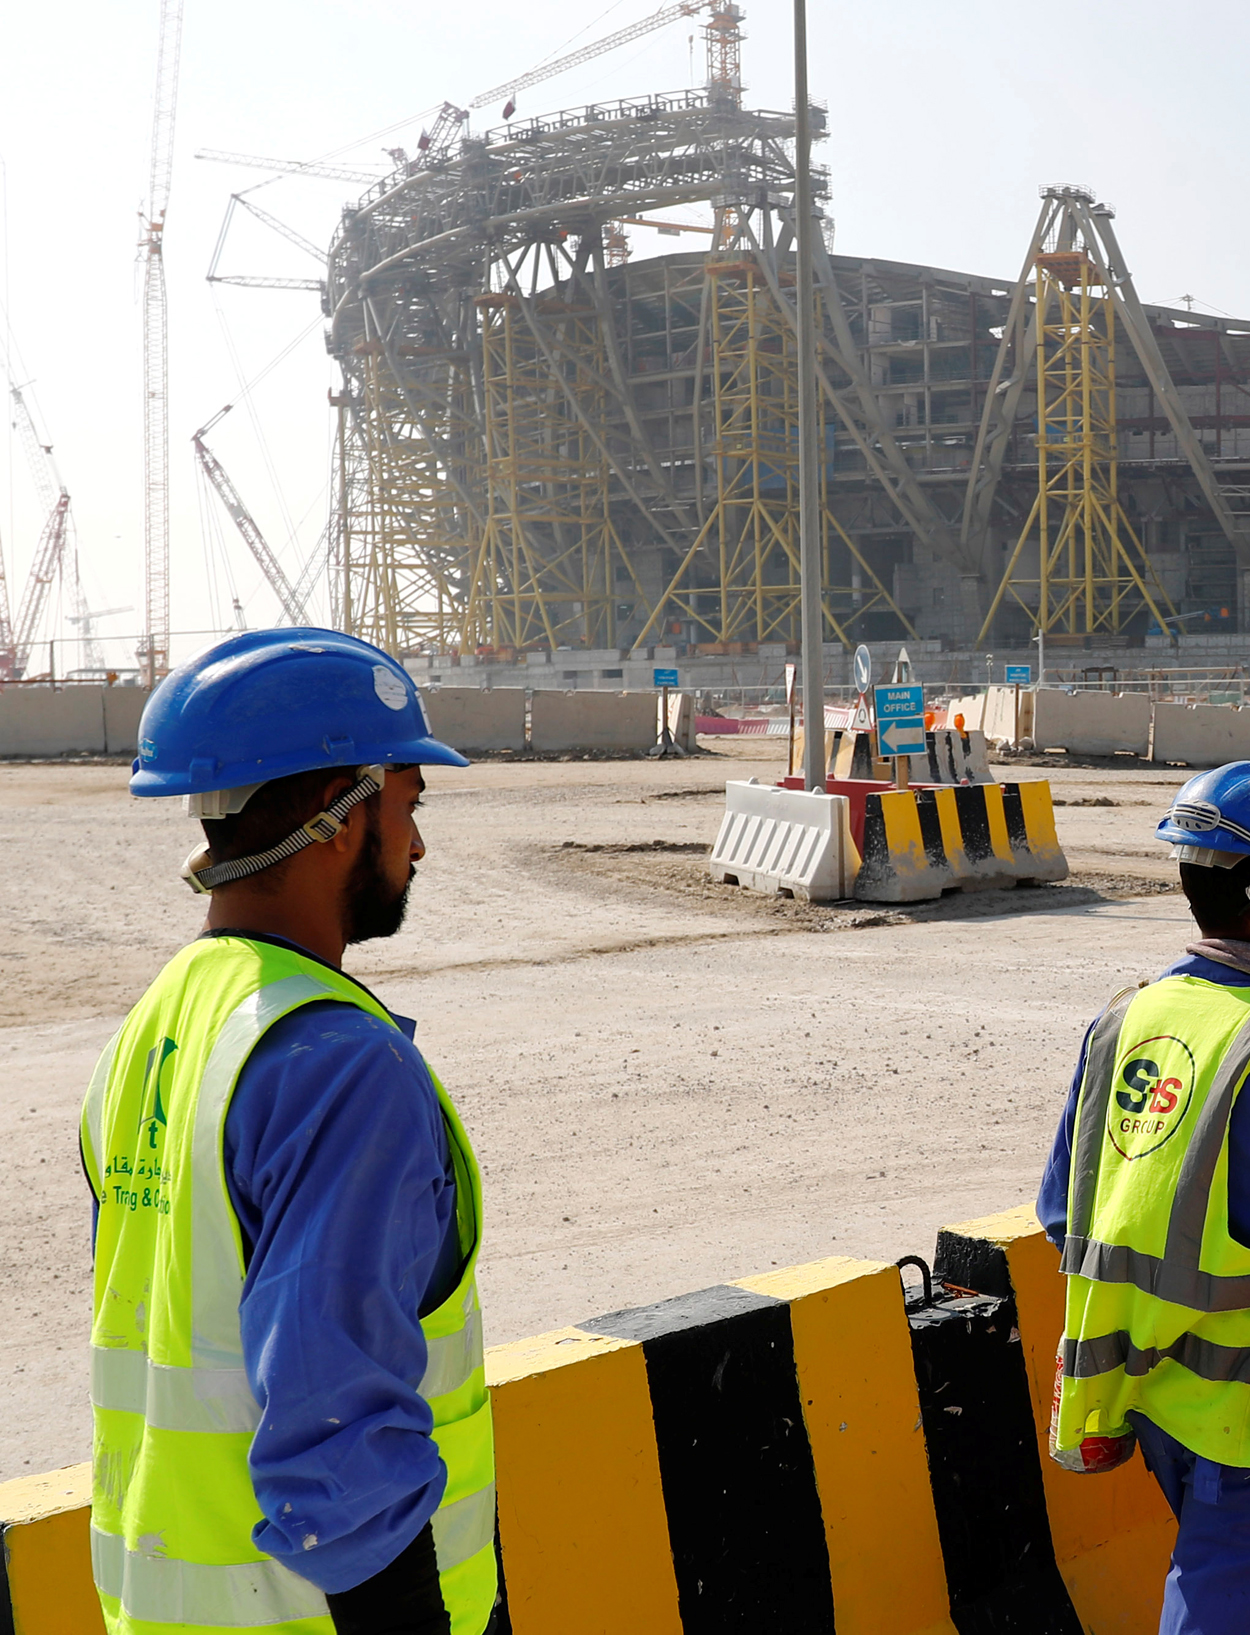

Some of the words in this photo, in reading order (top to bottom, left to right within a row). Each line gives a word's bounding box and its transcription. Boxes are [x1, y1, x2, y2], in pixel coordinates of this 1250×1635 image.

[887, 691, 911, 700] MAIN
[883, 702, 916, 713] OFFICE
[141, 1187, 152, 1207] &
